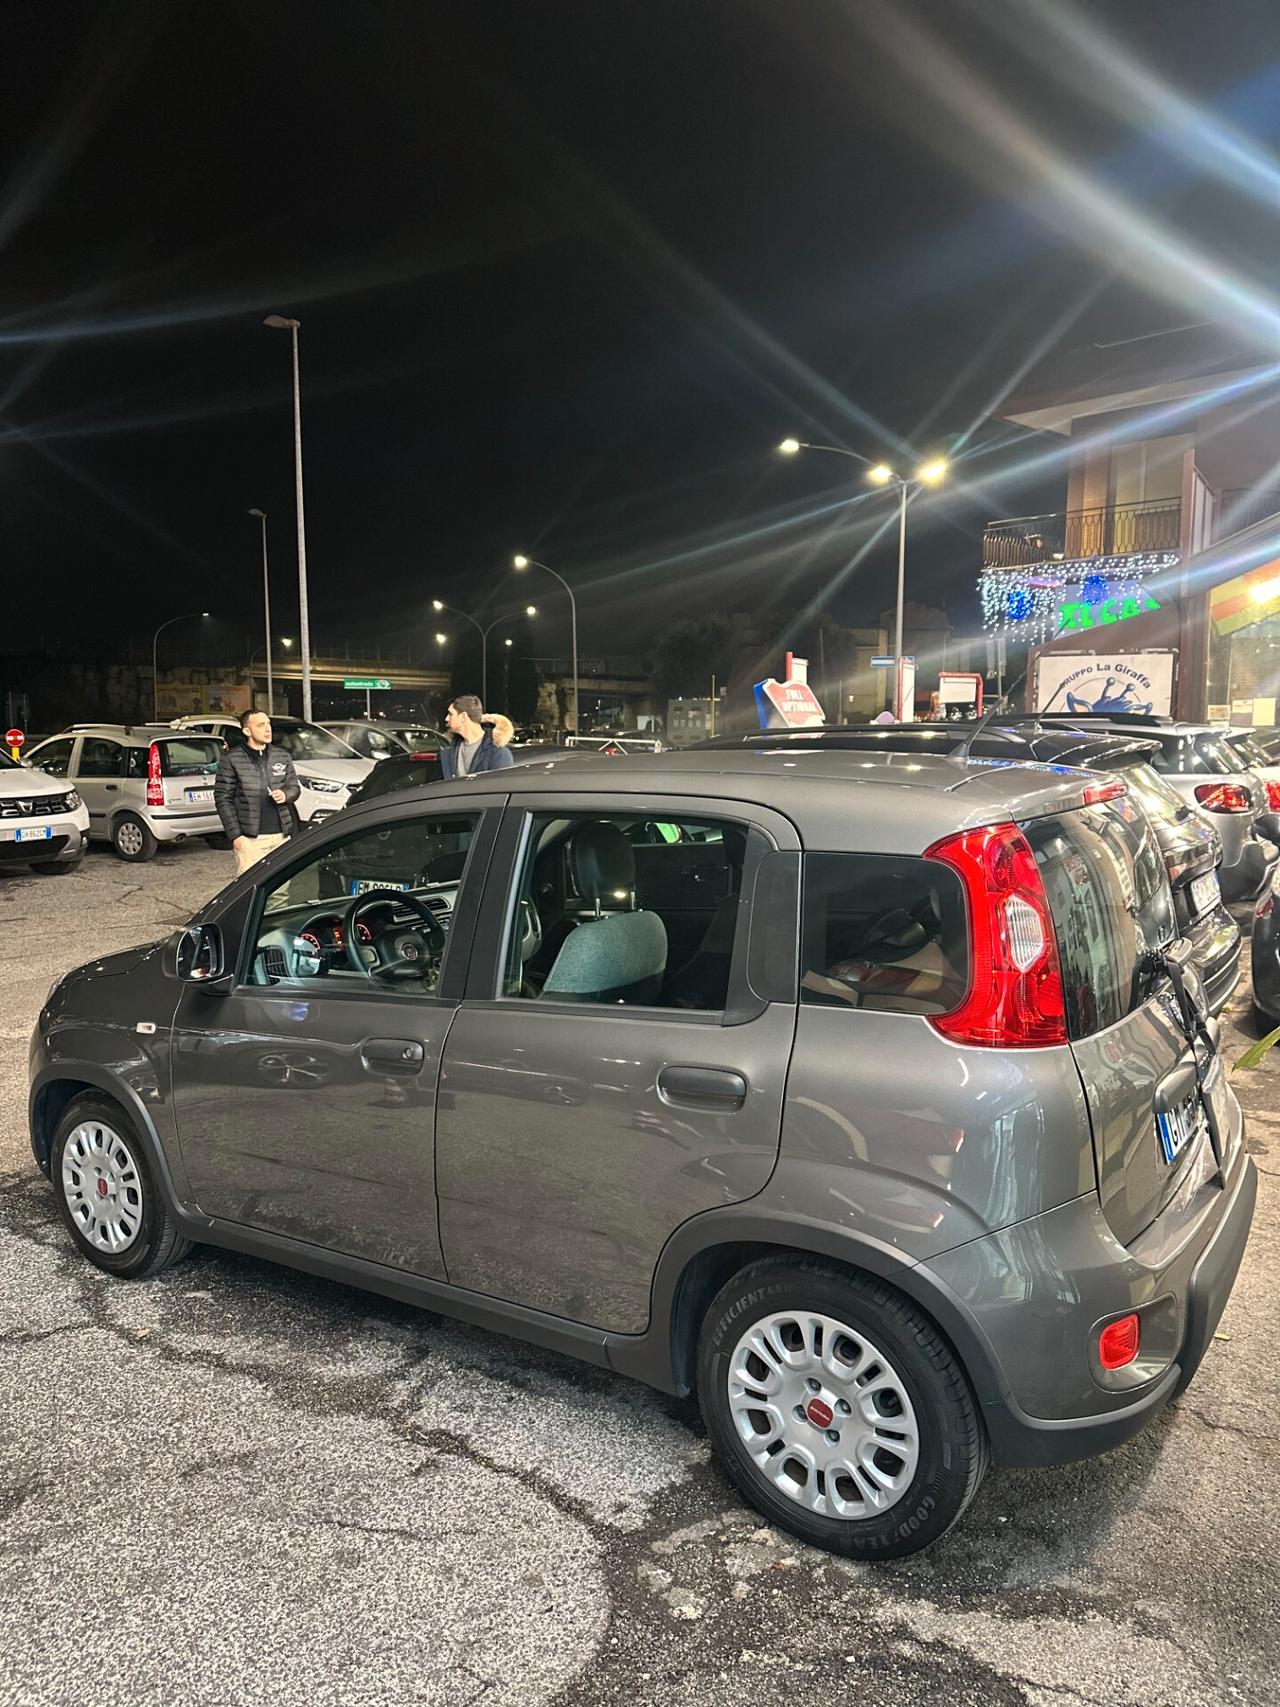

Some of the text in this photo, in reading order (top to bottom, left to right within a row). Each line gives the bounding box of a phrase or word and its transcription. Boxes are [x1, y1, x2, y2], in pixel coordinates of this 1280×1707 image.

[1096, 663, 1111, 672] La
[1114, 663, 1152, 690] Giraffa
[785, 689, 804, 701] FULL
[782, 701, 817, 713] OPTIONAL
[713, 1287, 765, 1346] EFFICIENT
